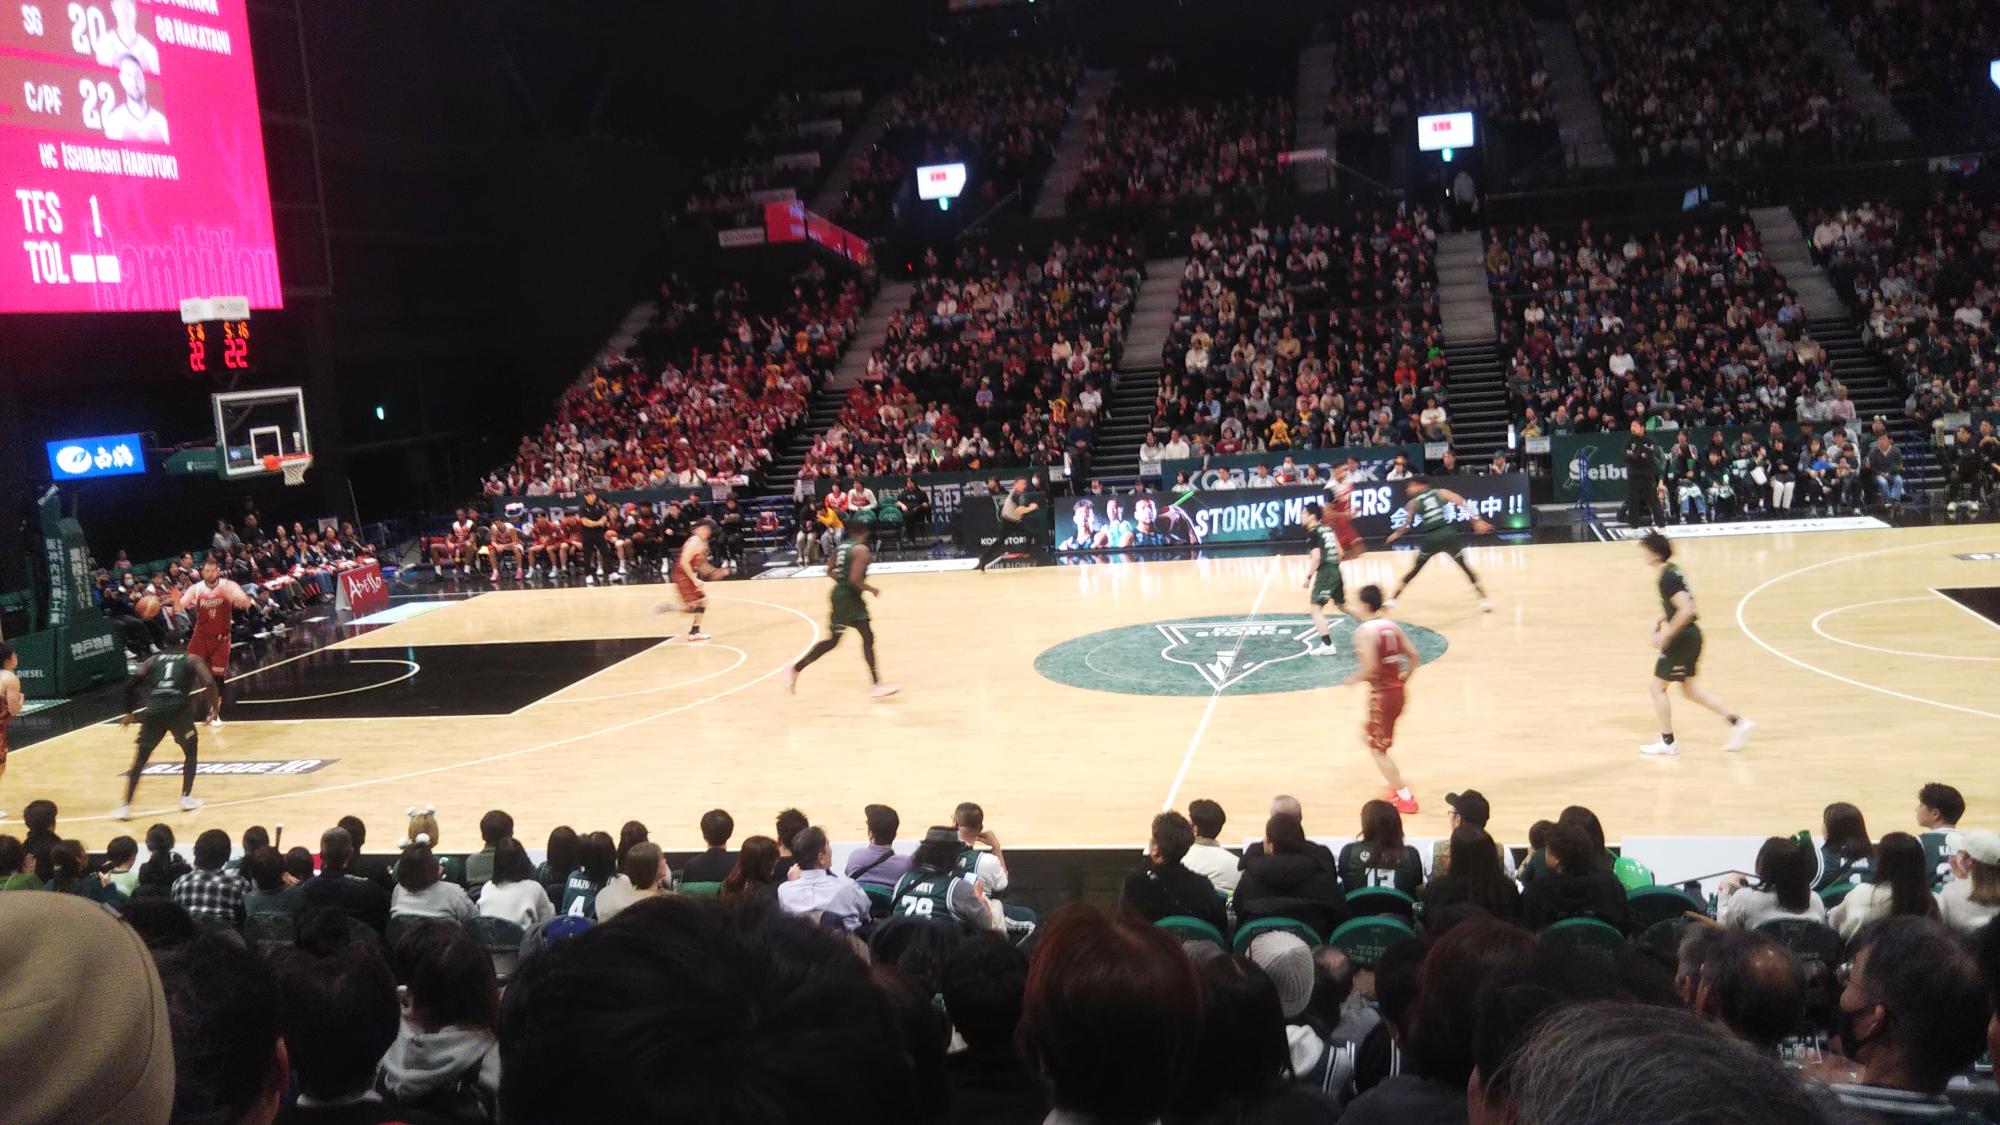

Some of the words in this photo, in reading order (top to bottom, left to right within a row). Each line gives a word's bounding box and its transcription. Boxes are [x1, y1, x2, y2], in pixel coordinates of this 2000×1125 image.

[68, 3, 108, 55] 20
[24, 81, 62, 115] C/PF
[79, 79, 117, 131] 22
[61, 142, 122, 175] ISHIBASHI
[120, 148, 179, 180] HARUYUKI
[16, 189, 63, 234] TFS
[89, 195, 102, 238] 1
[24, 241, 70, 284] TOL
[223, 338, 248, 368] 22
[1194, 500, 1280, 537] STORKS
[1283, 486, 1392, 526] MERS
[568, 896, 586, 918] 4
